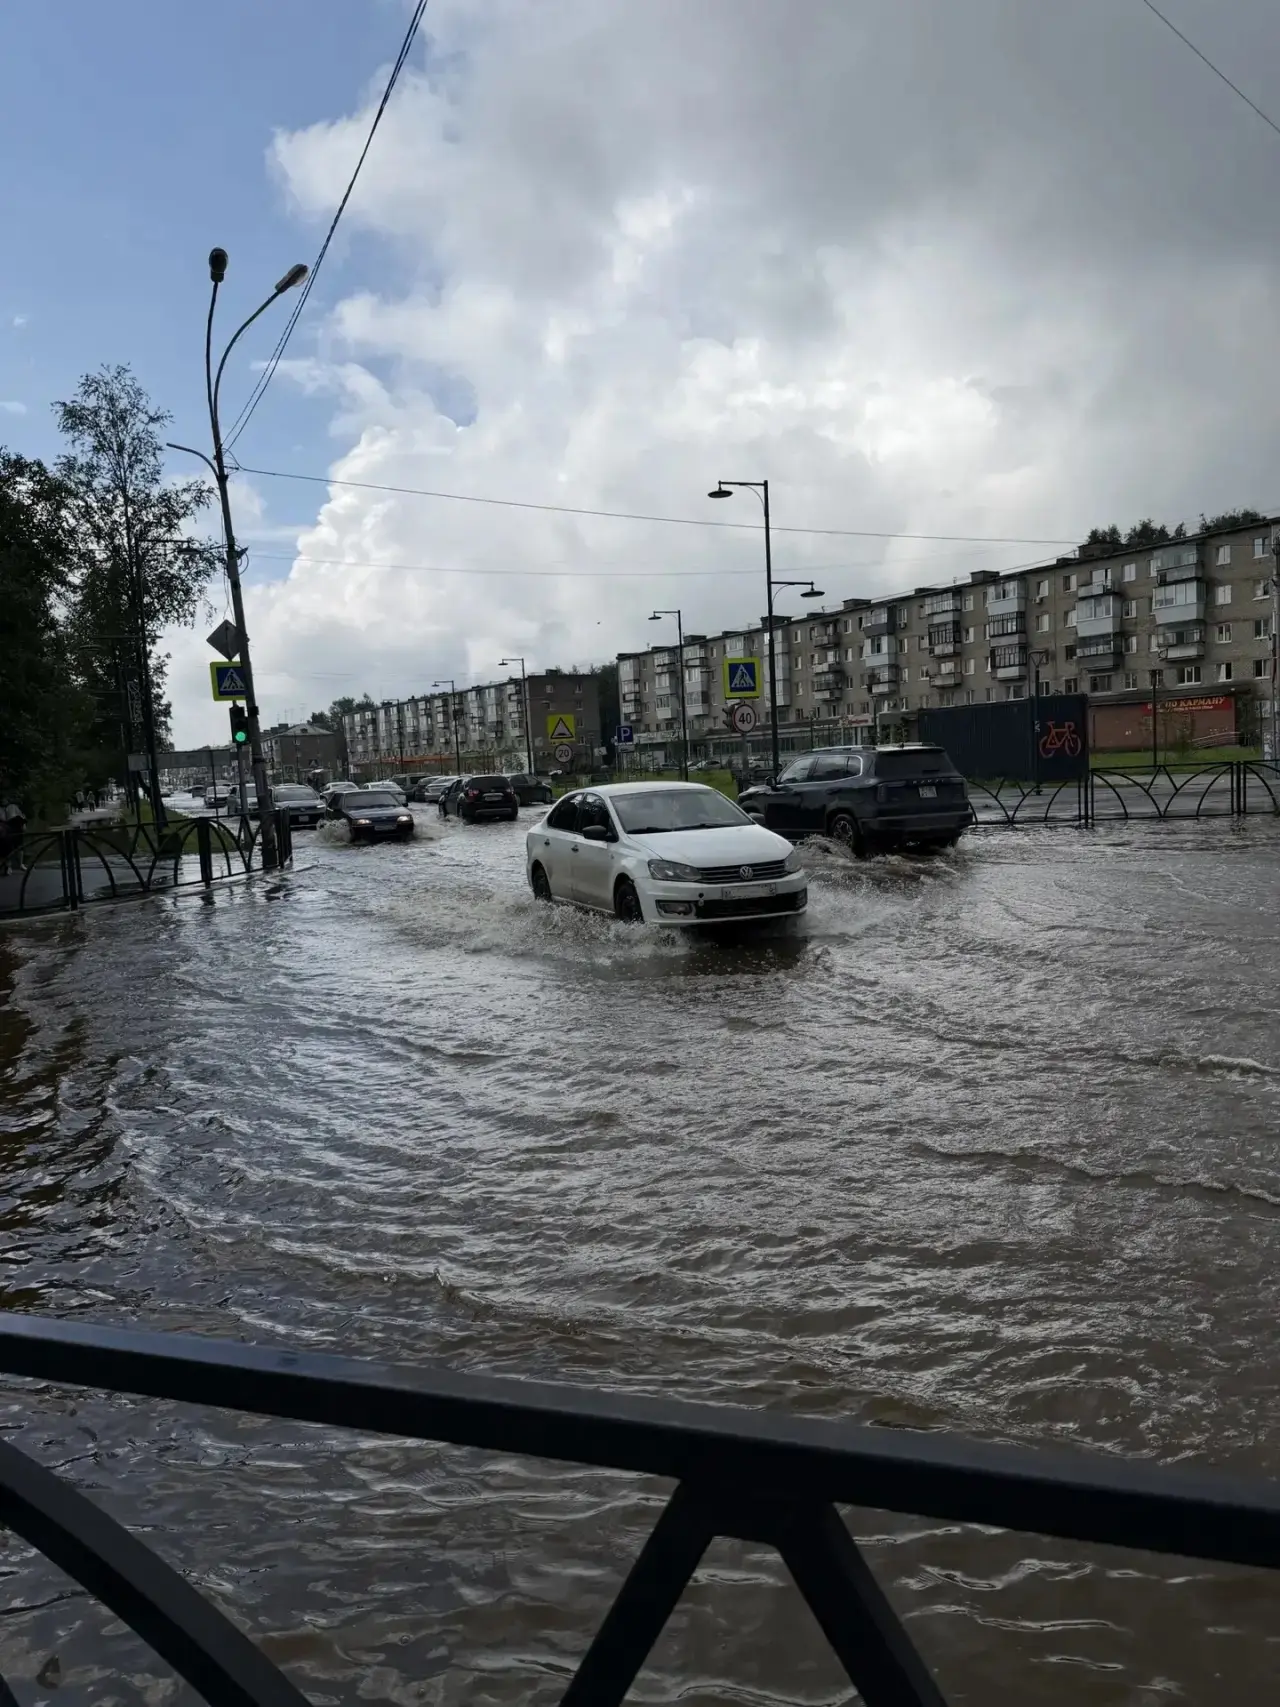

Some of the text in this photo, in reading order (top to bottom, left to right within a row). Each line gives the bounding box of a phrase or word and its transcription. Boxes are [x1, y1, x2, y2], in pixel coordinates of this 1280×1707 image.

[1180, 696, 1226, 707] КАРМАНУ
[739, 712, 752, 725] 40
[621, 727, 631, 741] P
[558, 749, 570, 758] 20
